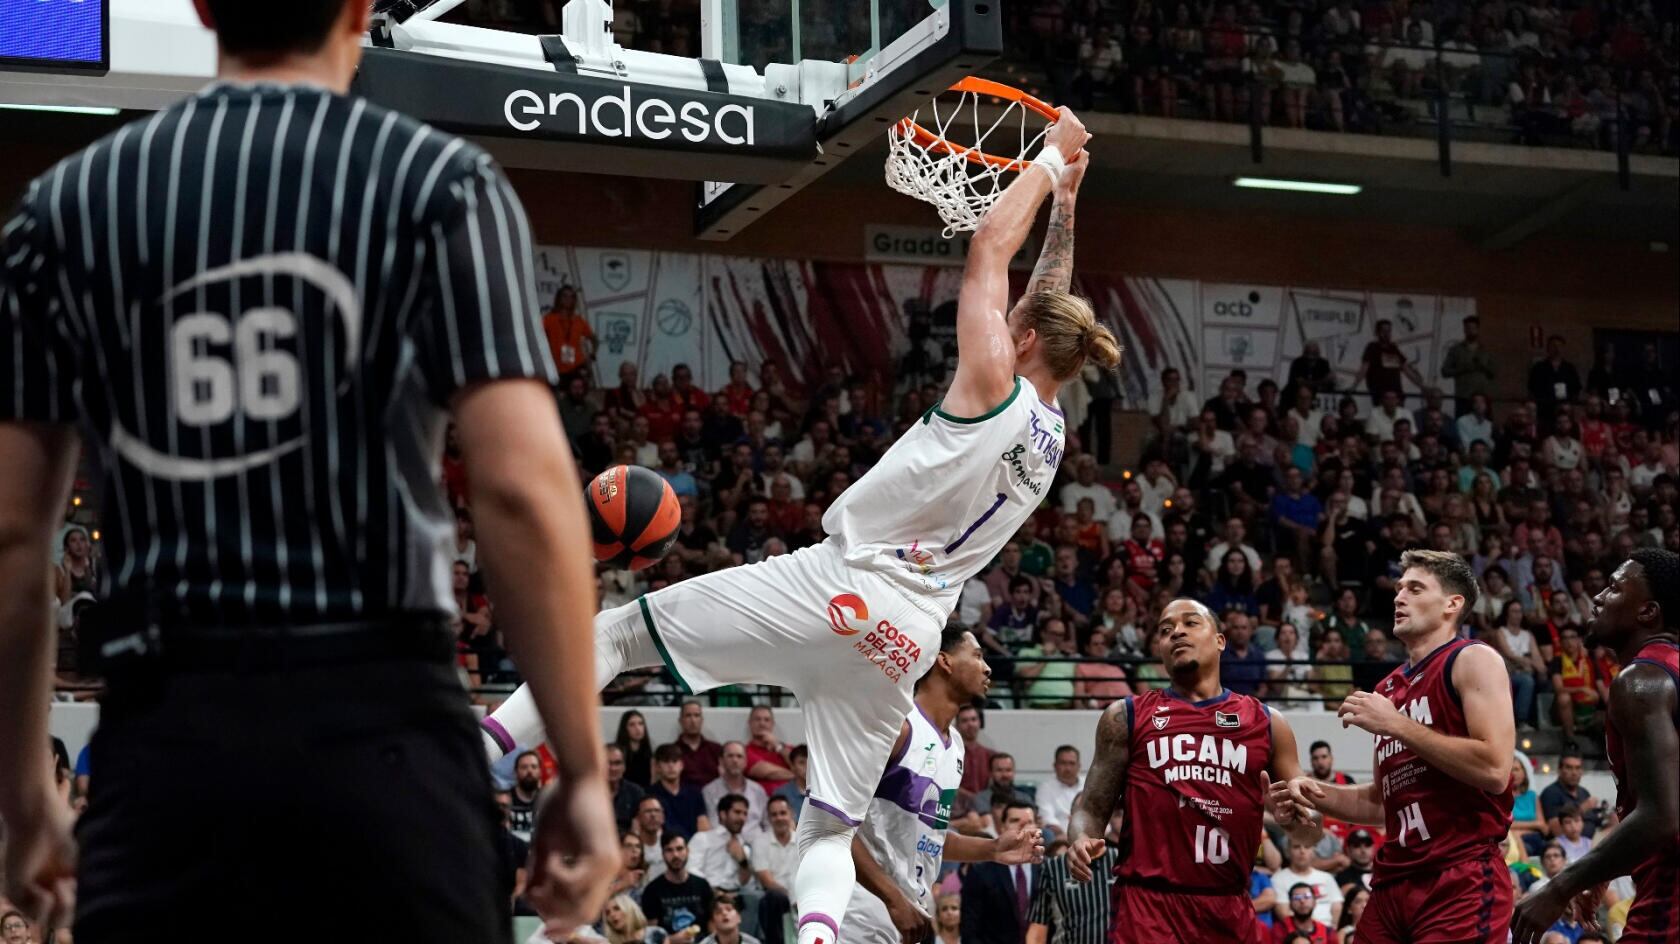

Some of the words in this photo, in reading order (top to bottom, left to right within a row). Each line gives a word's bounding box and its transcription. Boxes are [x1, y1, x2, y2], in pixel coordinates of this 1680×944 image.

[504, 85, 755, 146] endesa
[873, 233, 950, 256] Grada
[1213, 300, 1253, 318] acb
[172, 307, 300, 427] 66
[944, 492, 1008, 555] 1
[864, 631, 888, 654] DEL
[888, 650, 911, 674] SOL
[877, 620, 921, 662] COSTA
[853, 641, 901, 684] MÁLAGA
[1146, 733, 1248, 775] UCAM
[1164, 765, 1232, 787] MURCIA
[1219, 807, 1233, 815] 2024
[1397, 801, 1431, 848] 14
[1194, 824, 1230, 865] 10
